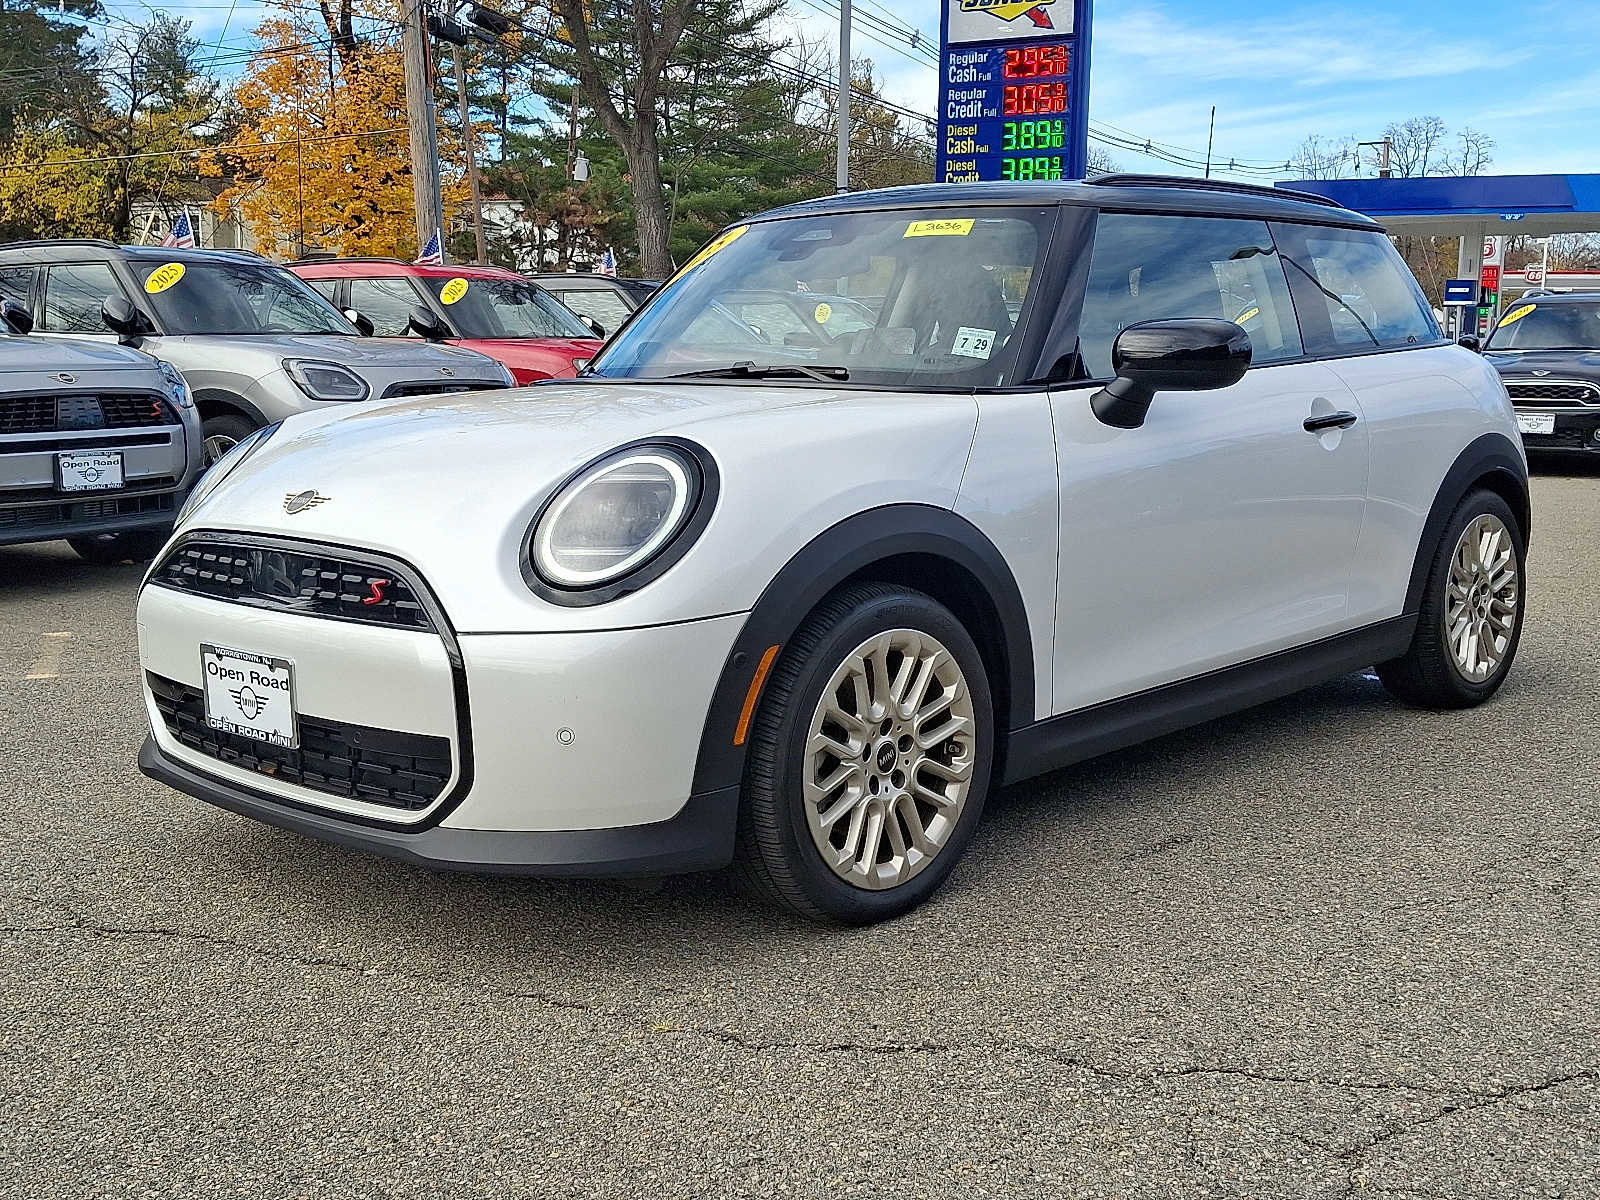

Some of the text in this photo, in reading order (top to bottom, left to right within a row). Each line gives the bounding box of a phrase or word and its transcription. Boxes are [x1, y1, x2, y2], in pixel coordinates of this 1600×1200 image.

[950, 52, 989, 66] Regular
[949, 65, 992, 83] Cash Full
[948, 88, 987, 102] Regular
[1004, 85, 1052, 114] 3.05
[948, 100, 997, 118] Credit Full
[947, 123, 978, 136] Diesel
[1003, 121, 1051, 150] 3.89
[946, 136, 989, 154] Cash Full
[946, 159, 976, 171] Diesel
[1002, 157, 1049, 181] 389
[152, 265, 179, 289] 2025
[445, 280, 464, 301] 2025
[961, 337, 988, 350] 7 29
[361, 579, 392, 606] S
[207, 661, 290, 691] Open Road
[210, 718, 291, 748] OPEN ROAD MINI
